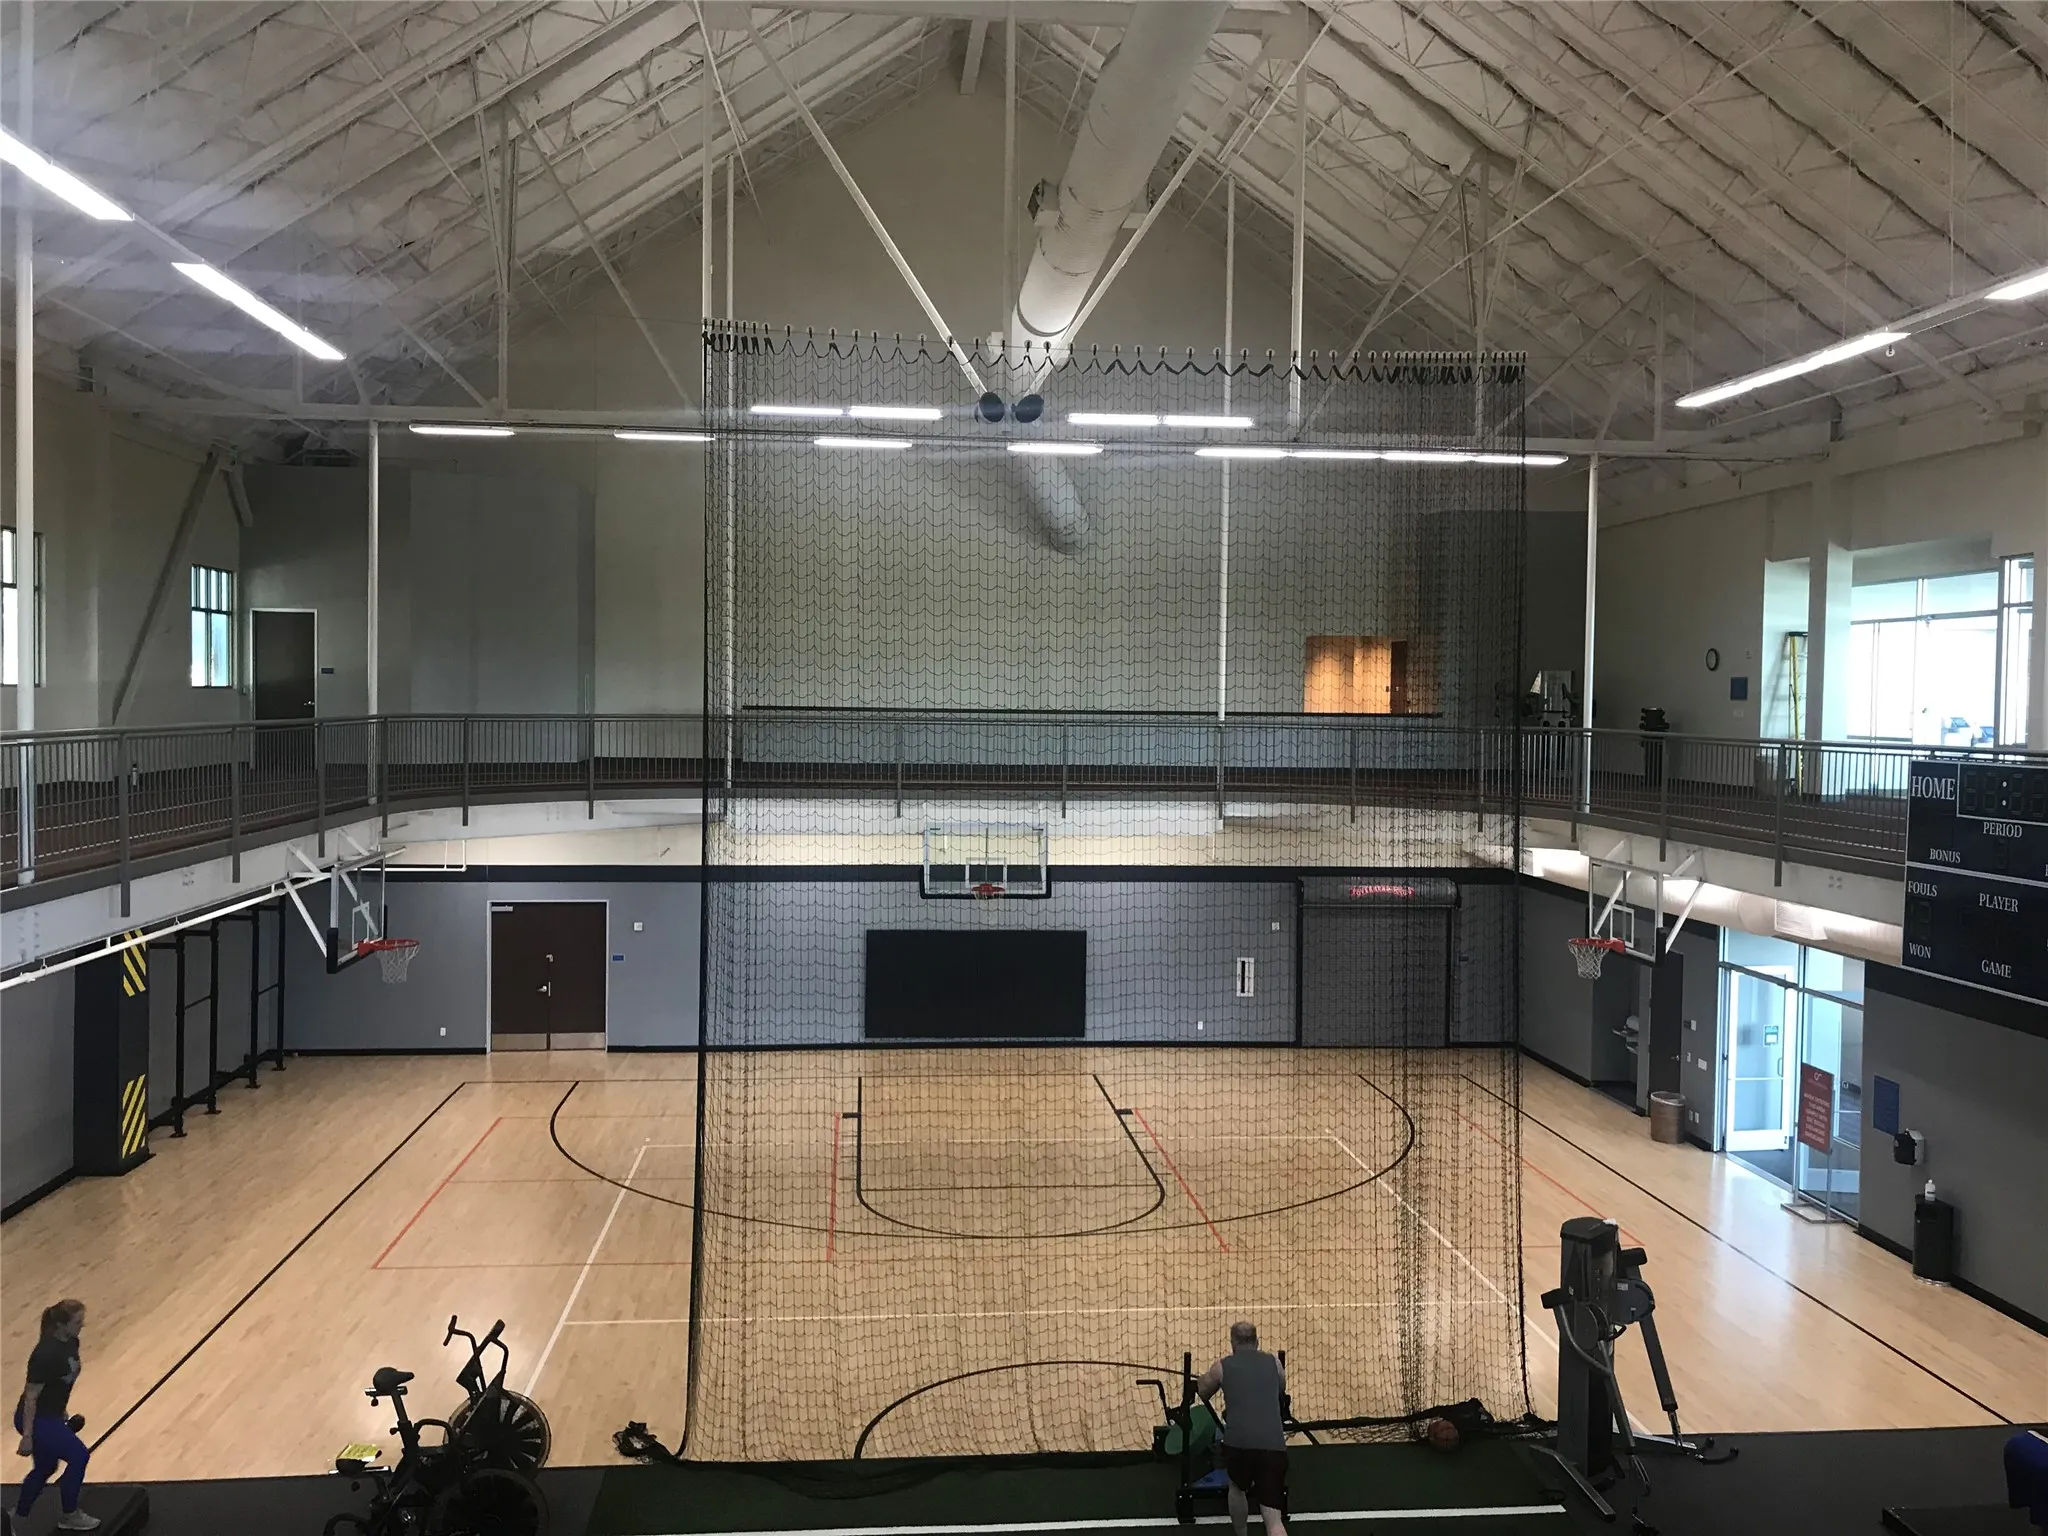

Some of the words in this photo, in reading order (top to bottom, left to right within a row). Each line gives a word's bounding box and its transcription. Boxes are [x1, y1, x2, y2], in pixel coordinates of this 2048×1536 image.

[1911, 776, 1955, 800] HOME
[1983, 821, 2022, 838] PERIOD
[1929, 848, 1961, 863] BONUS
[1908, 880, 1938, 897] FOULS
[1979, 893, 2019, 912] PLAYER
[1909, 942, 1932, 959] WON
[1981, 960, 2012, 979] GAME
